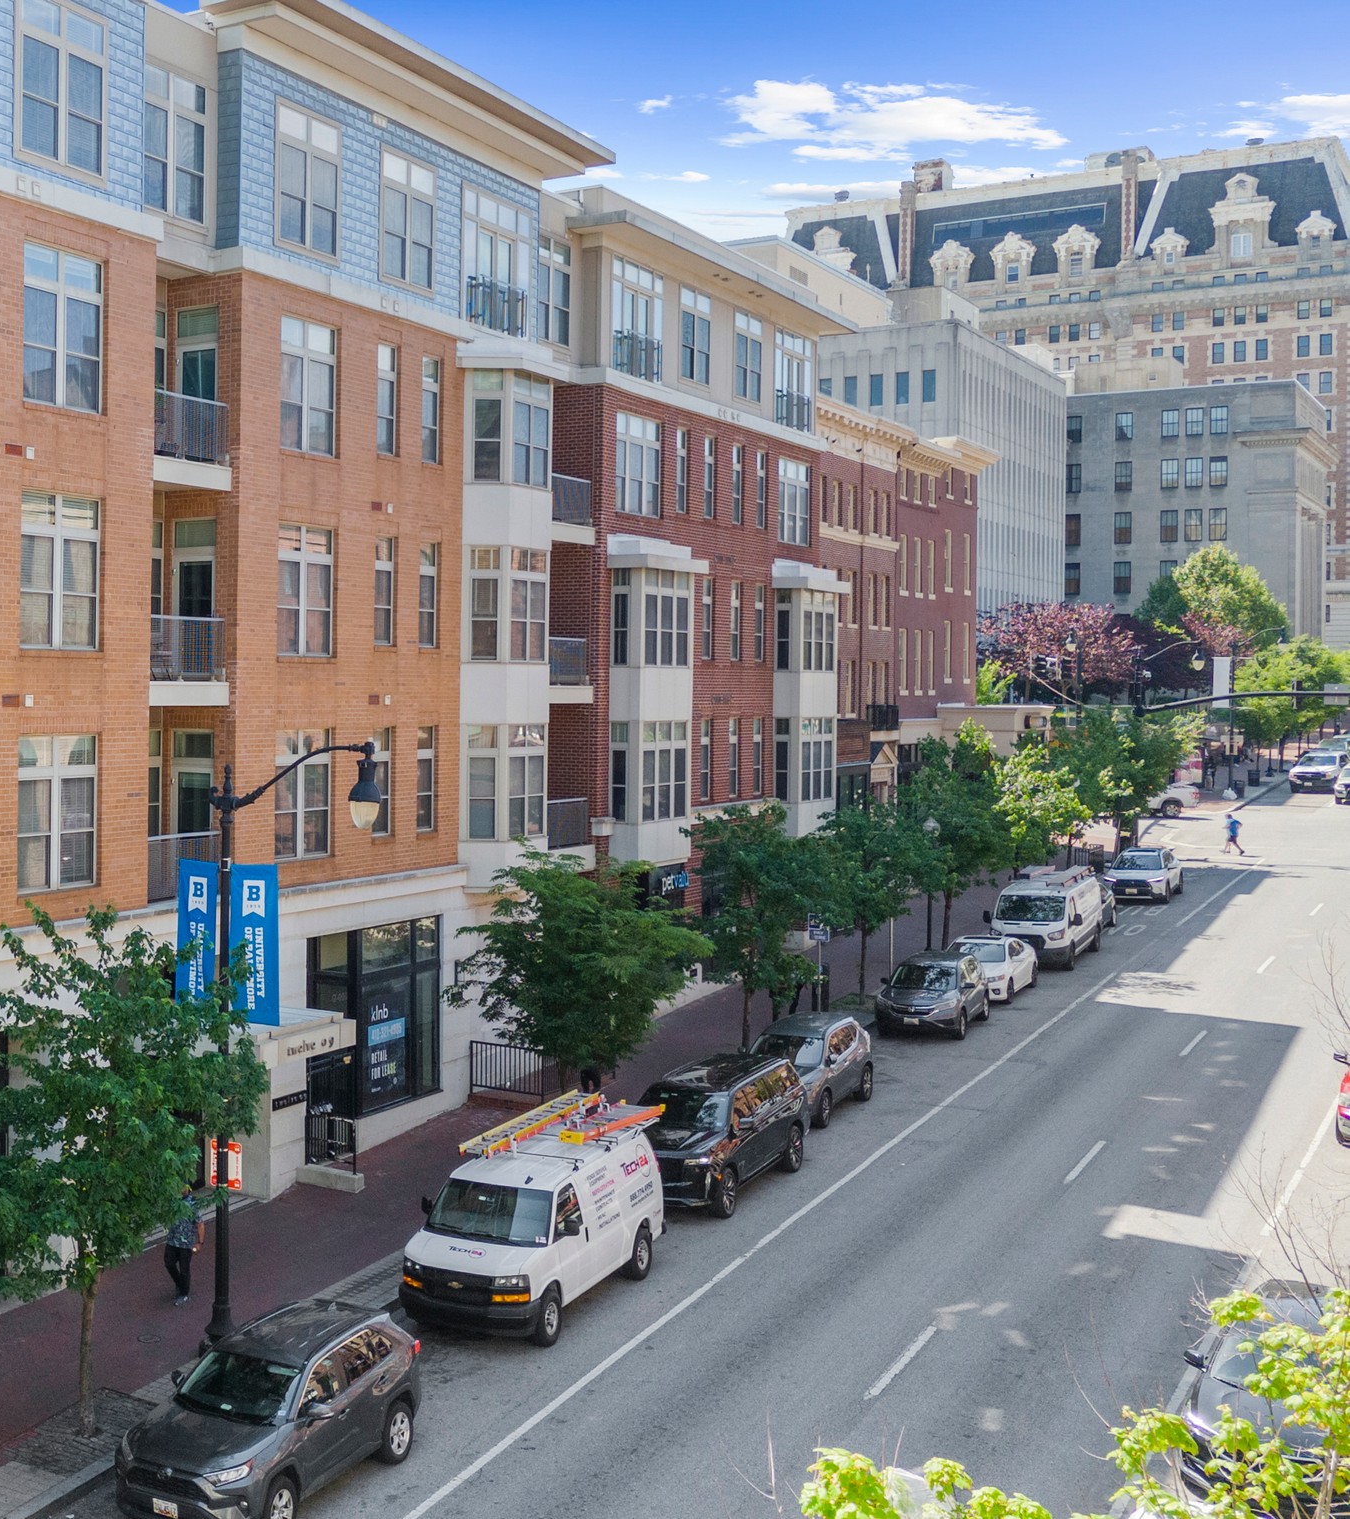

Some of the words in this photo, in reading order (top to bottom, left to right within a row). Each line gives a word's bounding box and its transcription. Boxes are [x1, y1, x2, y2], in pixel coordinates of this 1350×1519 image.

[192, 882, 204, 898] B
[247, 885, 261, 902] B
[245, 926, 253, 941] OF
[255, 927, 265, 998] UNIVERSITY
